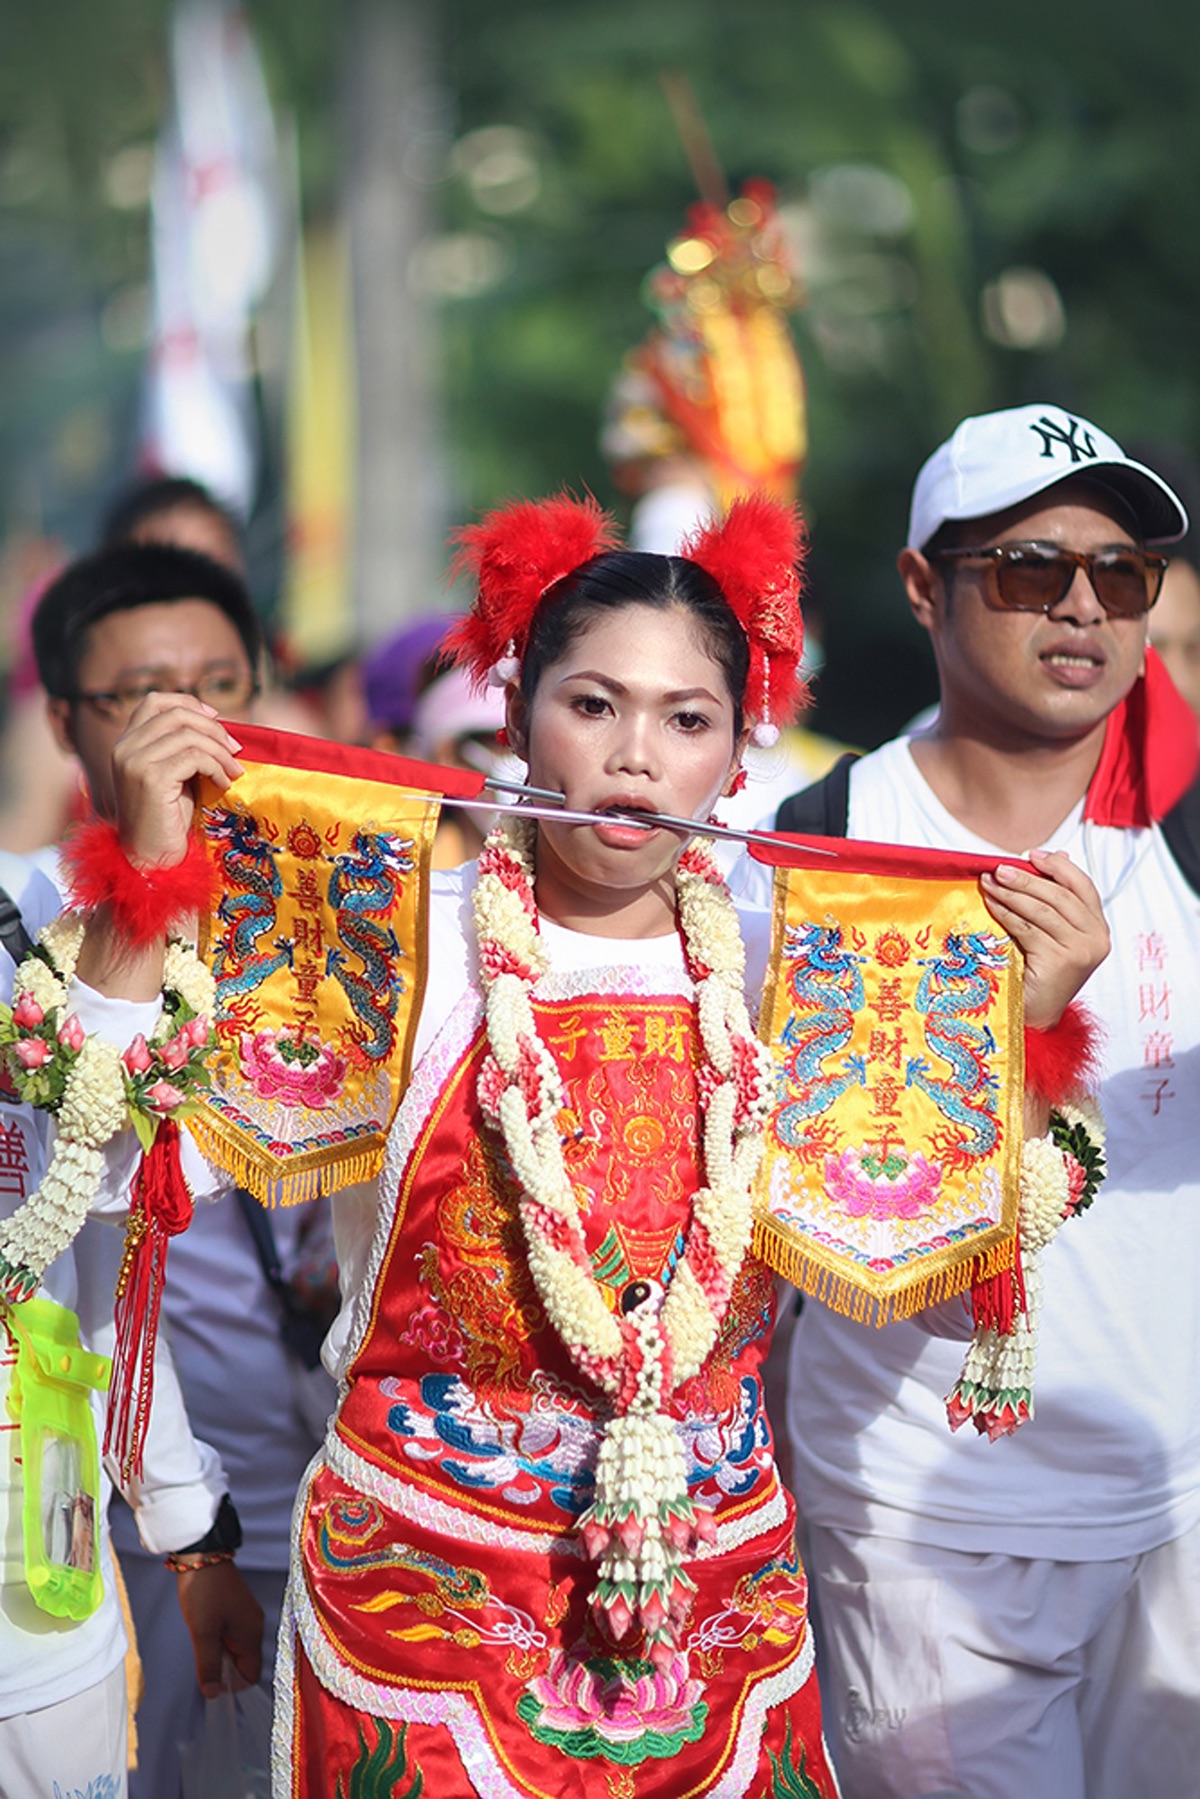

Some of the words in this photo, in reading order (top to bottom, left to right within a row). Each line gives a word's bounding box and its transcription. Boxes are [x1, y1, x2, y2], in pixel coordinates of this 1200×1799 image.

[1030, 417, 1097, 462] NY
[282, 869, 326, 1047] 善財童子
[1137, 930, 1176, 1116] 善財童子
[864, 977, 911, 1163] 善財童子
